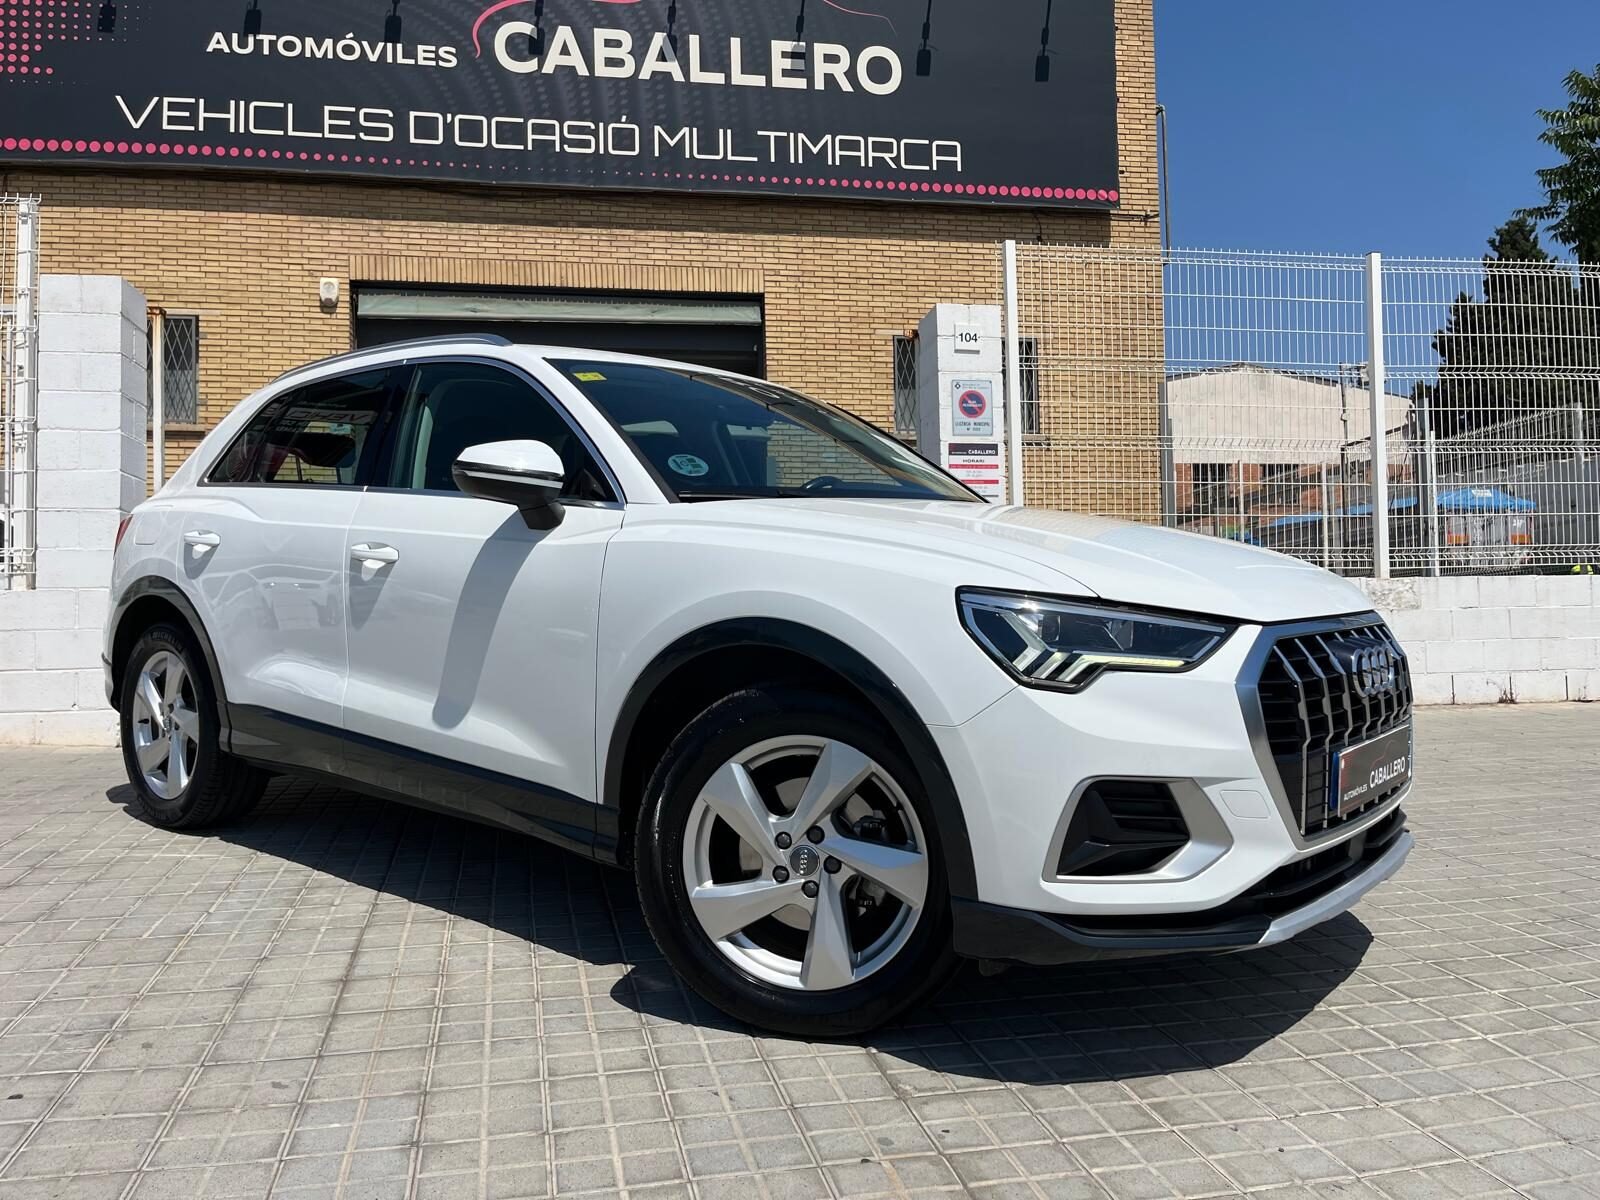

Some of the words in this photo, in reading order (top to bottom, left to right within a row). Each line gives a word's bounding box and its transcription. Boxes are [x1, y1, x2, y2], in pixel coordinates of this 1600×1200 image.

[205, 31, 458, 67] AUTOMÓVILES
[494, 21, 902, 96] CABALLERO
[115, 95, 394, 142] VEHICLES
[409, 110, 640, 157] D'OCASIÓ
[653, 125, 962, 172] MULTIMARCA
[958, 332, 978, 343] 104
[1369, 756, 1406, 789] CABALLERO
